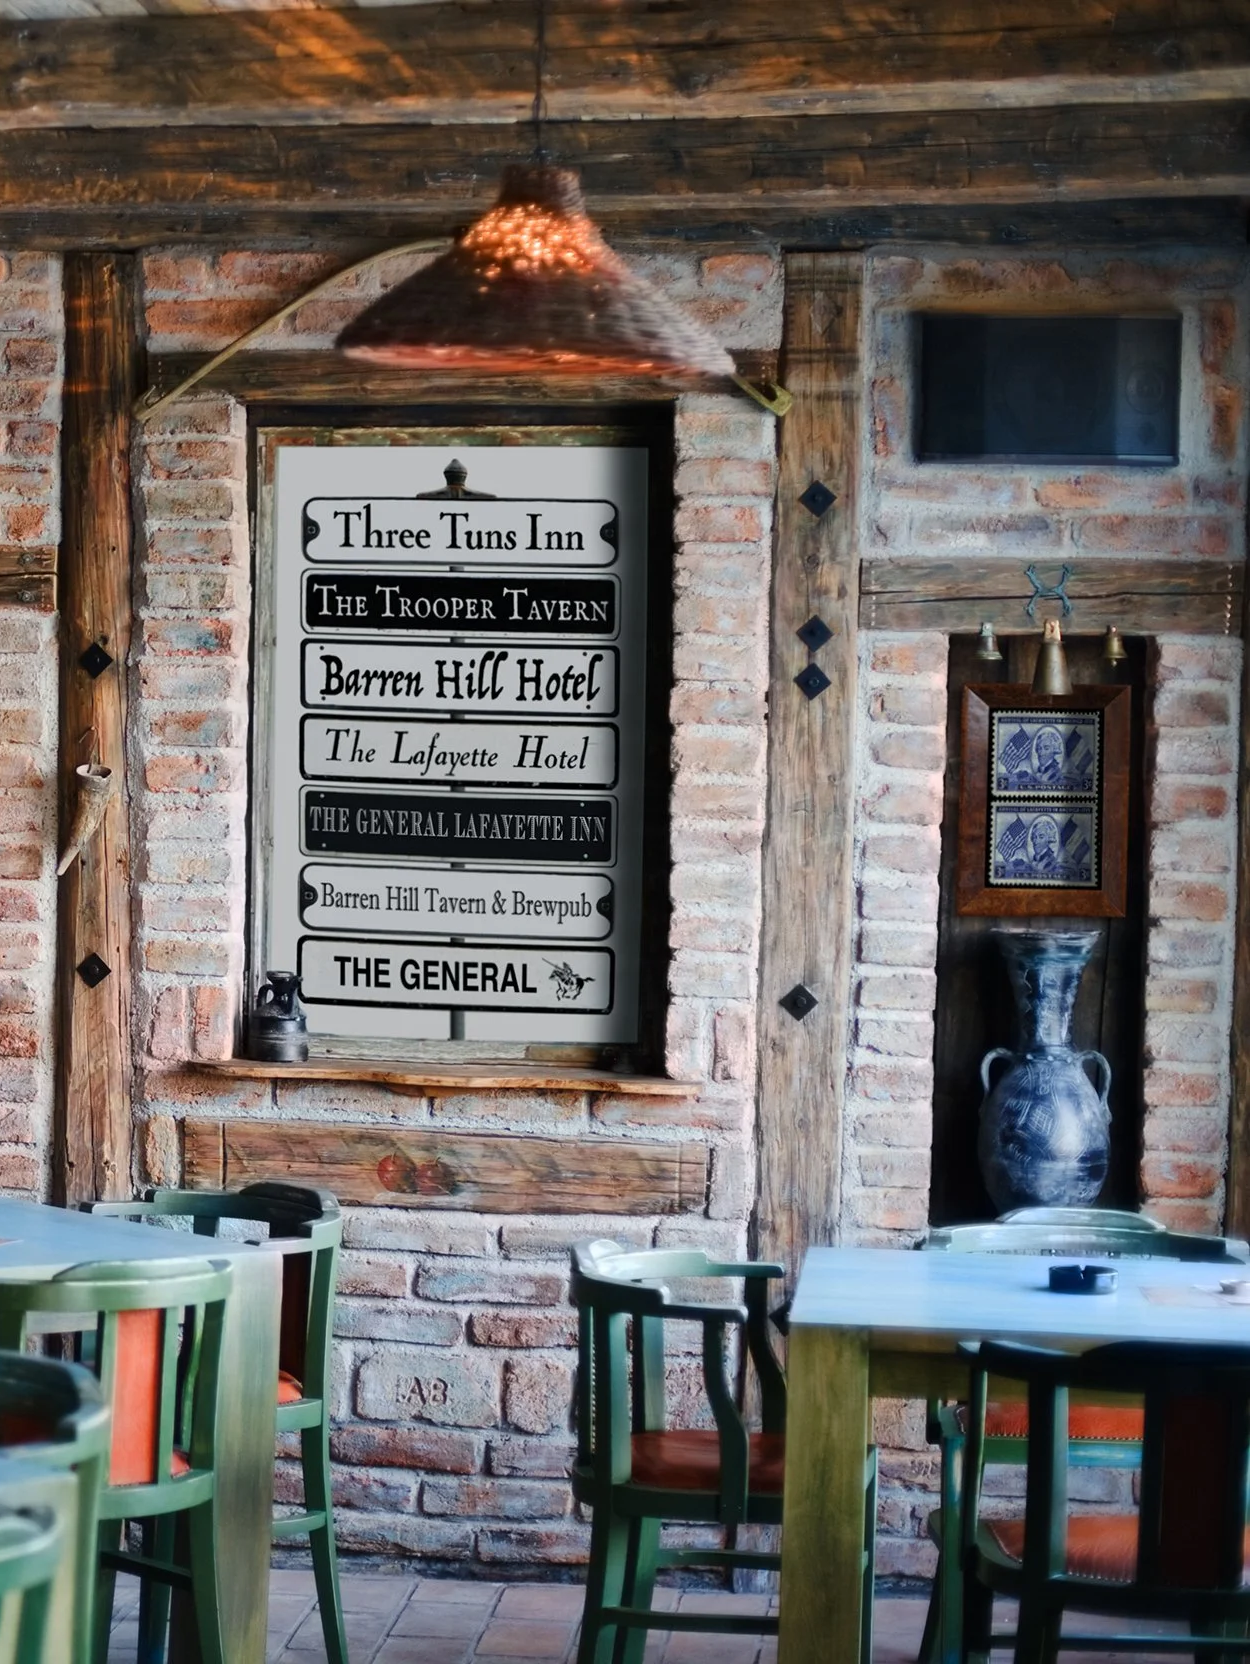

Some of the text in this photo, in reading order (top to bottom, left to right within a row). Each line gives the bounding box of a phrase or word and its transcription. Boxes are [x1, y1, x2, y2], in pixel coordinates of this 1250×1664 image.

[333, 503, 585, 551] Three Tuns Inn
[312, 583, 609, 622] THE TROOPER TAVERN
[319, 650, 604, 702] Barren Hill Hotel
[325, 728, 590, 777] The Lafayette Hotel
[309, 806, 607, 844] THE GENERAL LAFAYETTE INN
[320, 882, 593, 925] Barren Hill Tavern & Brewpub
[333, 955, 538, 994] THE GENERAL
